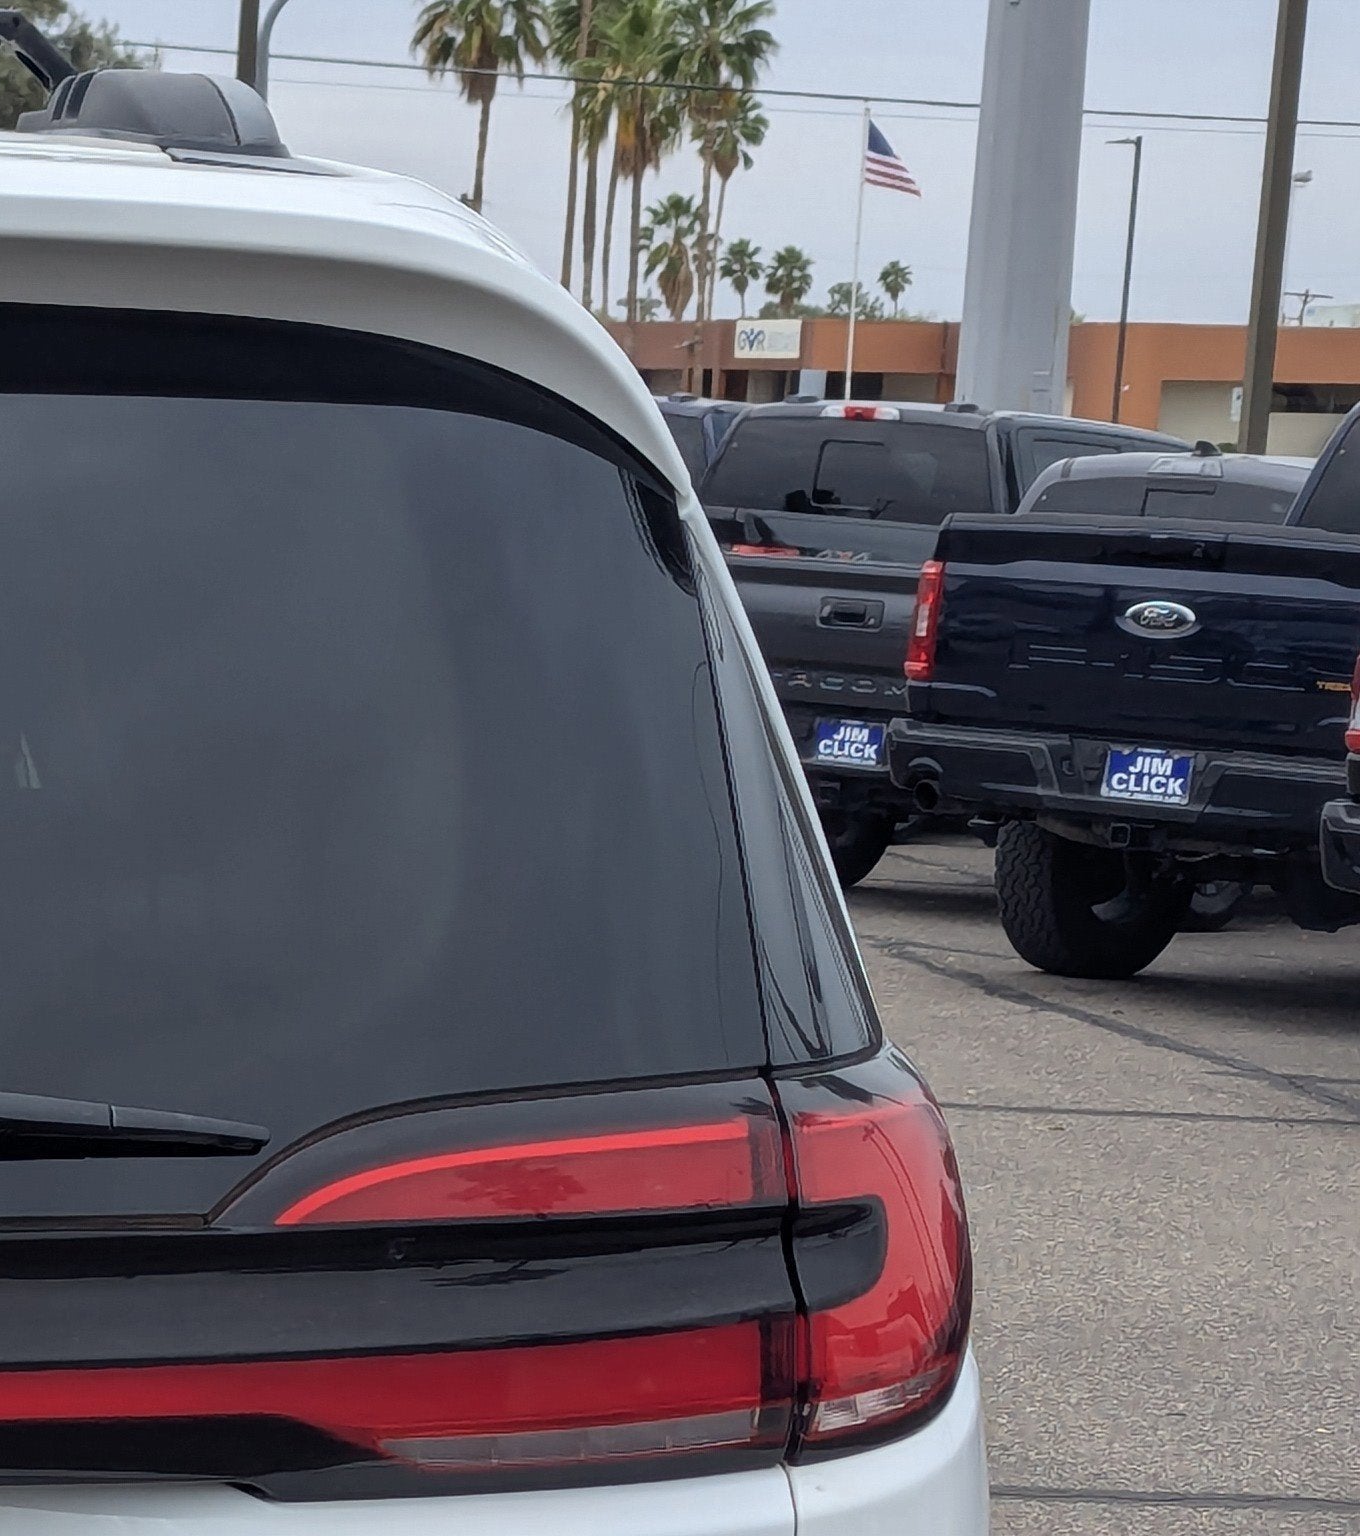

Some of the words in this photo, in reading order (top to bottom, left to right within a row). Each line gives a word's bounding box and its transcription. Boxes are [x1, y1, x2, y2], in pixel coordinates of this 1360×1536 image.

[832, 726, 869, 743] JIM
[818, 739, 879, 760] CLICK
[1128, 756, 1173, 776] JIM
[1110, 772, 1185, 796] CLICK
